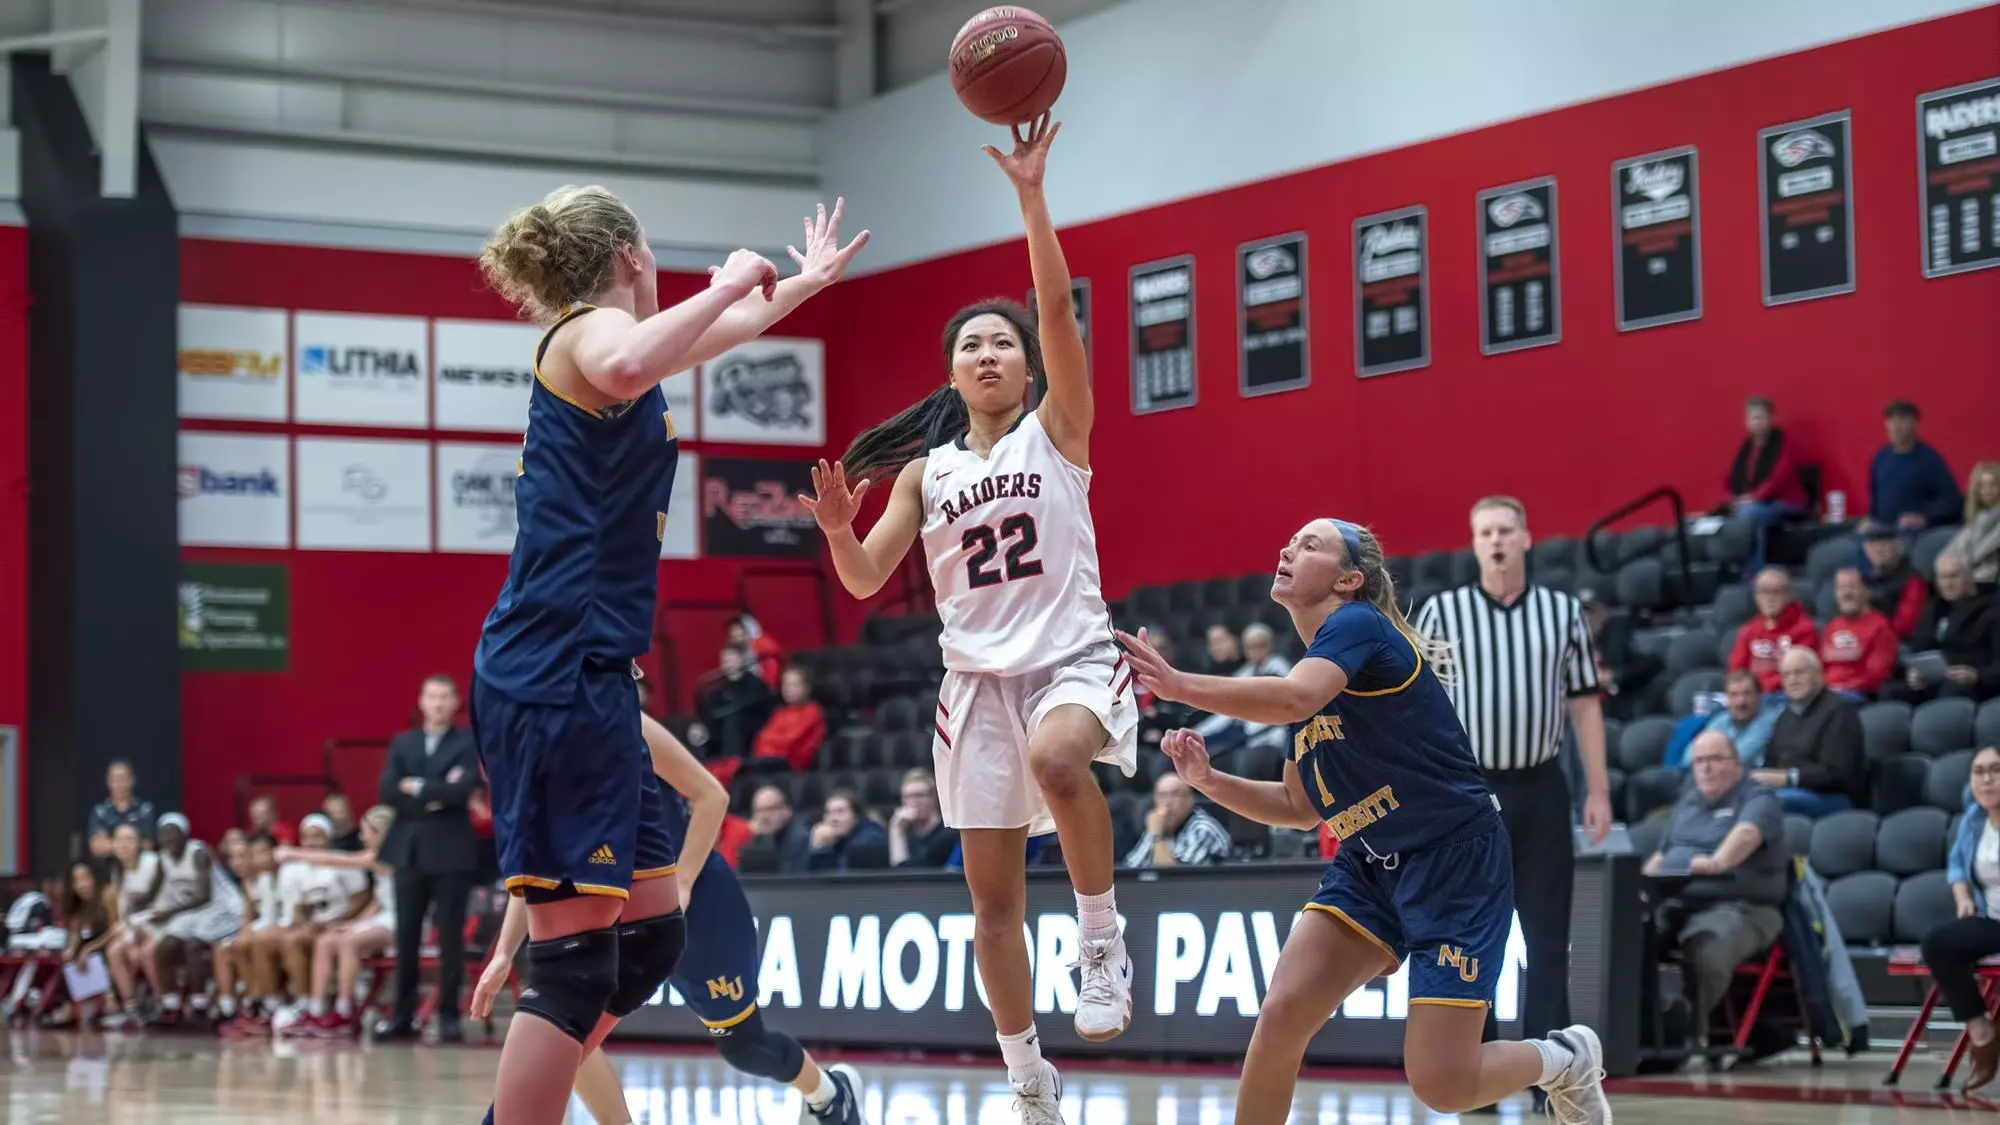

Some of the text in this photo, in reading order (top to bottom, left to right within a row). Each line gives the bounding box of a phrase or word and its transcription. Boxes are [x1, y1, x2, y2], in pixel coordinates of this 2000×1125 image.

[328, 346, 419, 379] LITHIA
[940, 472, 1042, 525] RAIDERS
[961, 512, 1044, 590] 22
[588, 856, 617, 865] adidas
[1437, 944, 1479, 982] NU
[706, 975, 745, 1001] NU
